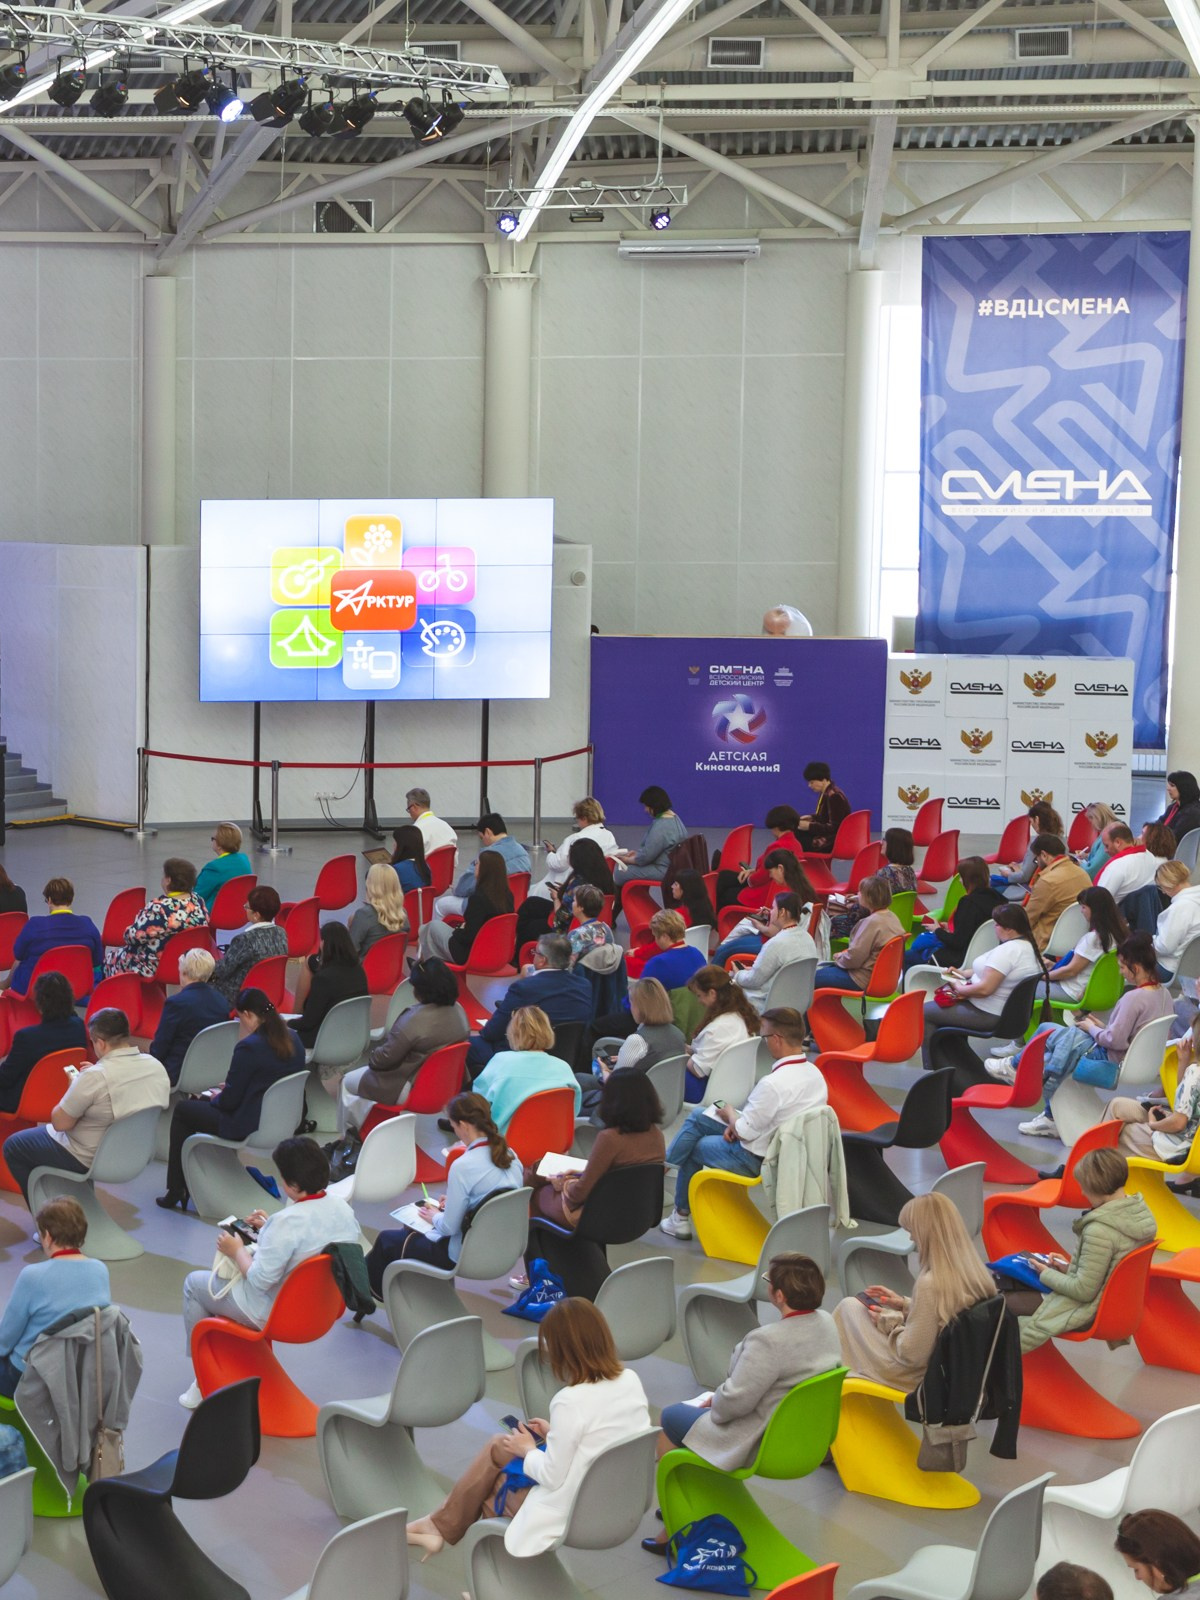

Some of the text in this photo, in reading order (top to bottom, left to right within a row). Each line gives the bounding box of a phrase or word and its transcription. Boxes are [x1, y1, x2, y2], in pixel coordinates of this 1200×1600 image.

[978, 297, 1131, 319] #ВДЦСМЕНА
[941, 469, 1153, 500] СМЕНА
[332, 579, 415, 616] АРКТУР
[950, 682, 1004, 692] СМЕНА
[1074, 683, 1129, 693] СМЕНА
[889, 737, 942, 747] СМЕНА
[1011, 740, 1065, 750] СМЕНА
[708, 751, 767, 762] ДЕТСКАЯ
[695, 762, 781, 773] КиноакадемиЯ
[947, 797, 1000, 806] СМЕНА
